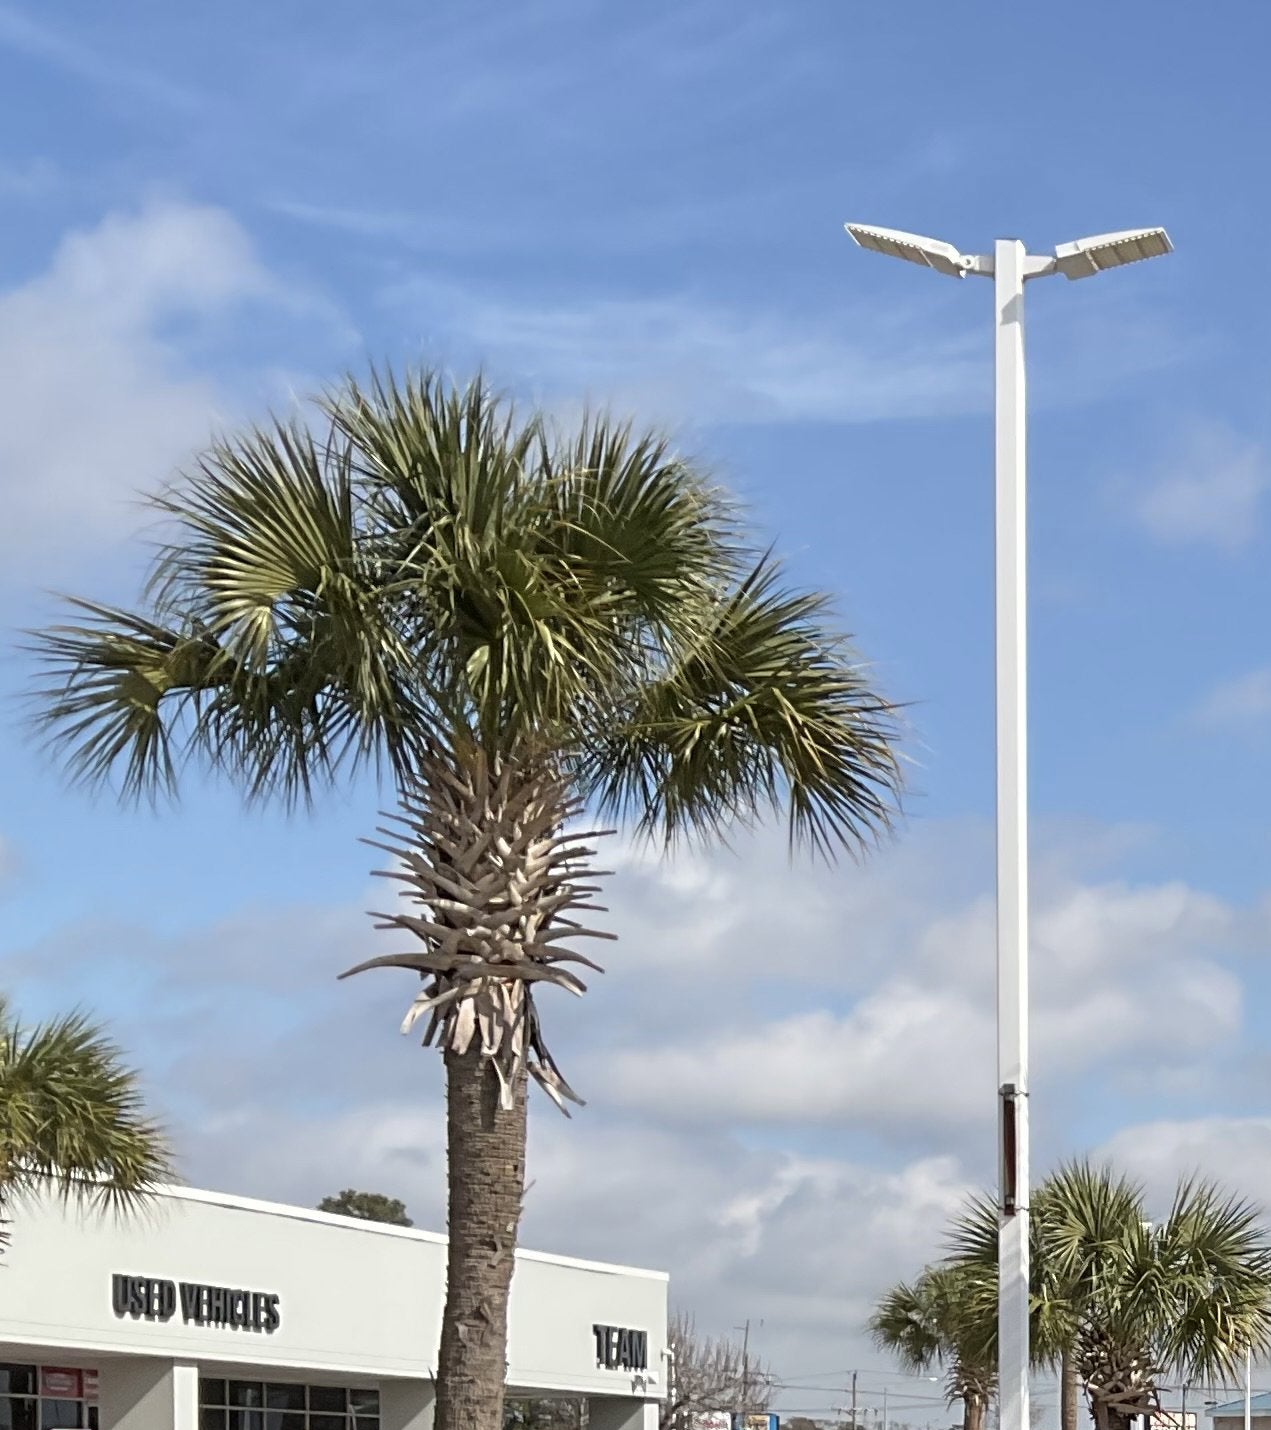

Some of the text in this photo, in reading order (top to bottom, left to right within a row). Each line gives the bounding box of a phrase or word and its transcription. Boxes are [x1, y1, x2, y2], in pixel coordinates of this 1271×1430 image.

[112, 1273, 281, 1335] USED VEHICLES
[592, 1324, 648, 1372] TEAM
